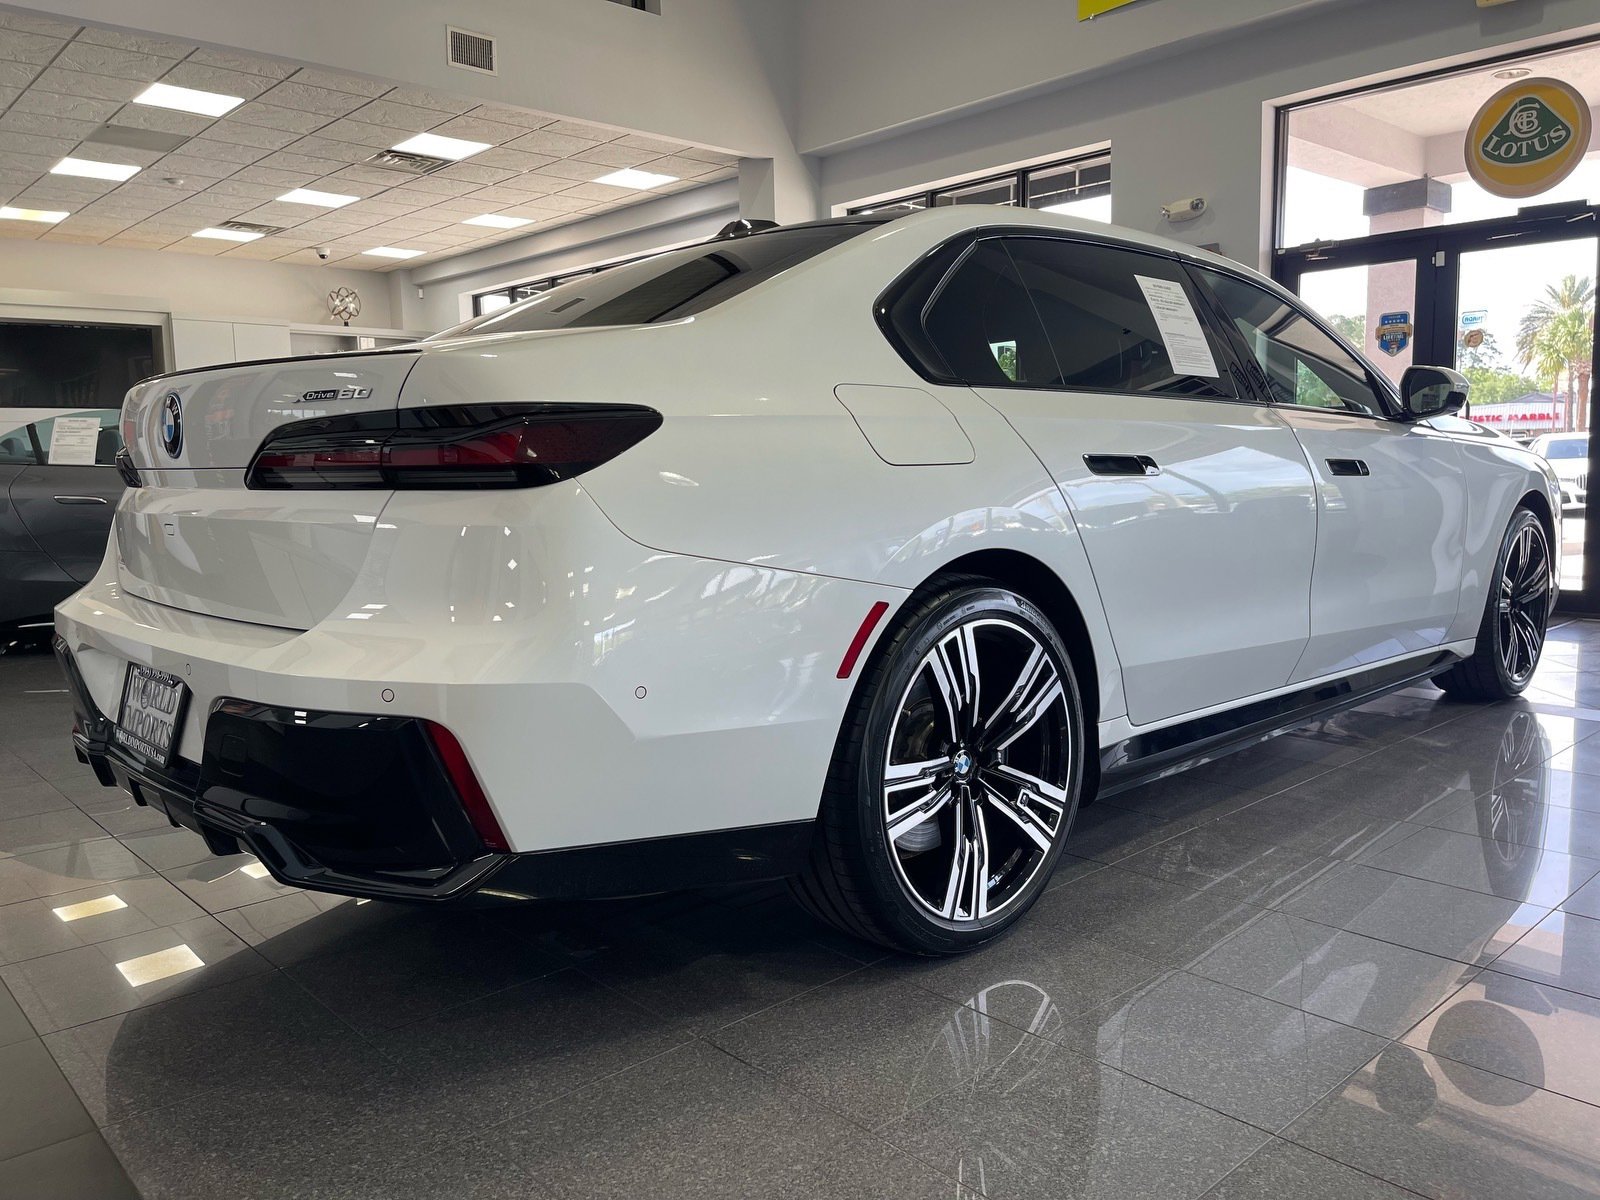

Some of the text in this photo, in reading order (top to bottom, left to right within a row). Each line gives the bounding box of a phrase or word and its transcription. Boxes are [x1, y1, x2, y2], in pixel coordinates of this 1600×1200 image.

[1484, 125, 1567, 158] LOTUS
[1508, 412, 1560, 421] MARBLE
[133, 675, 178, 715] WORLD
[121, 705, 173, 750] MPORTS
